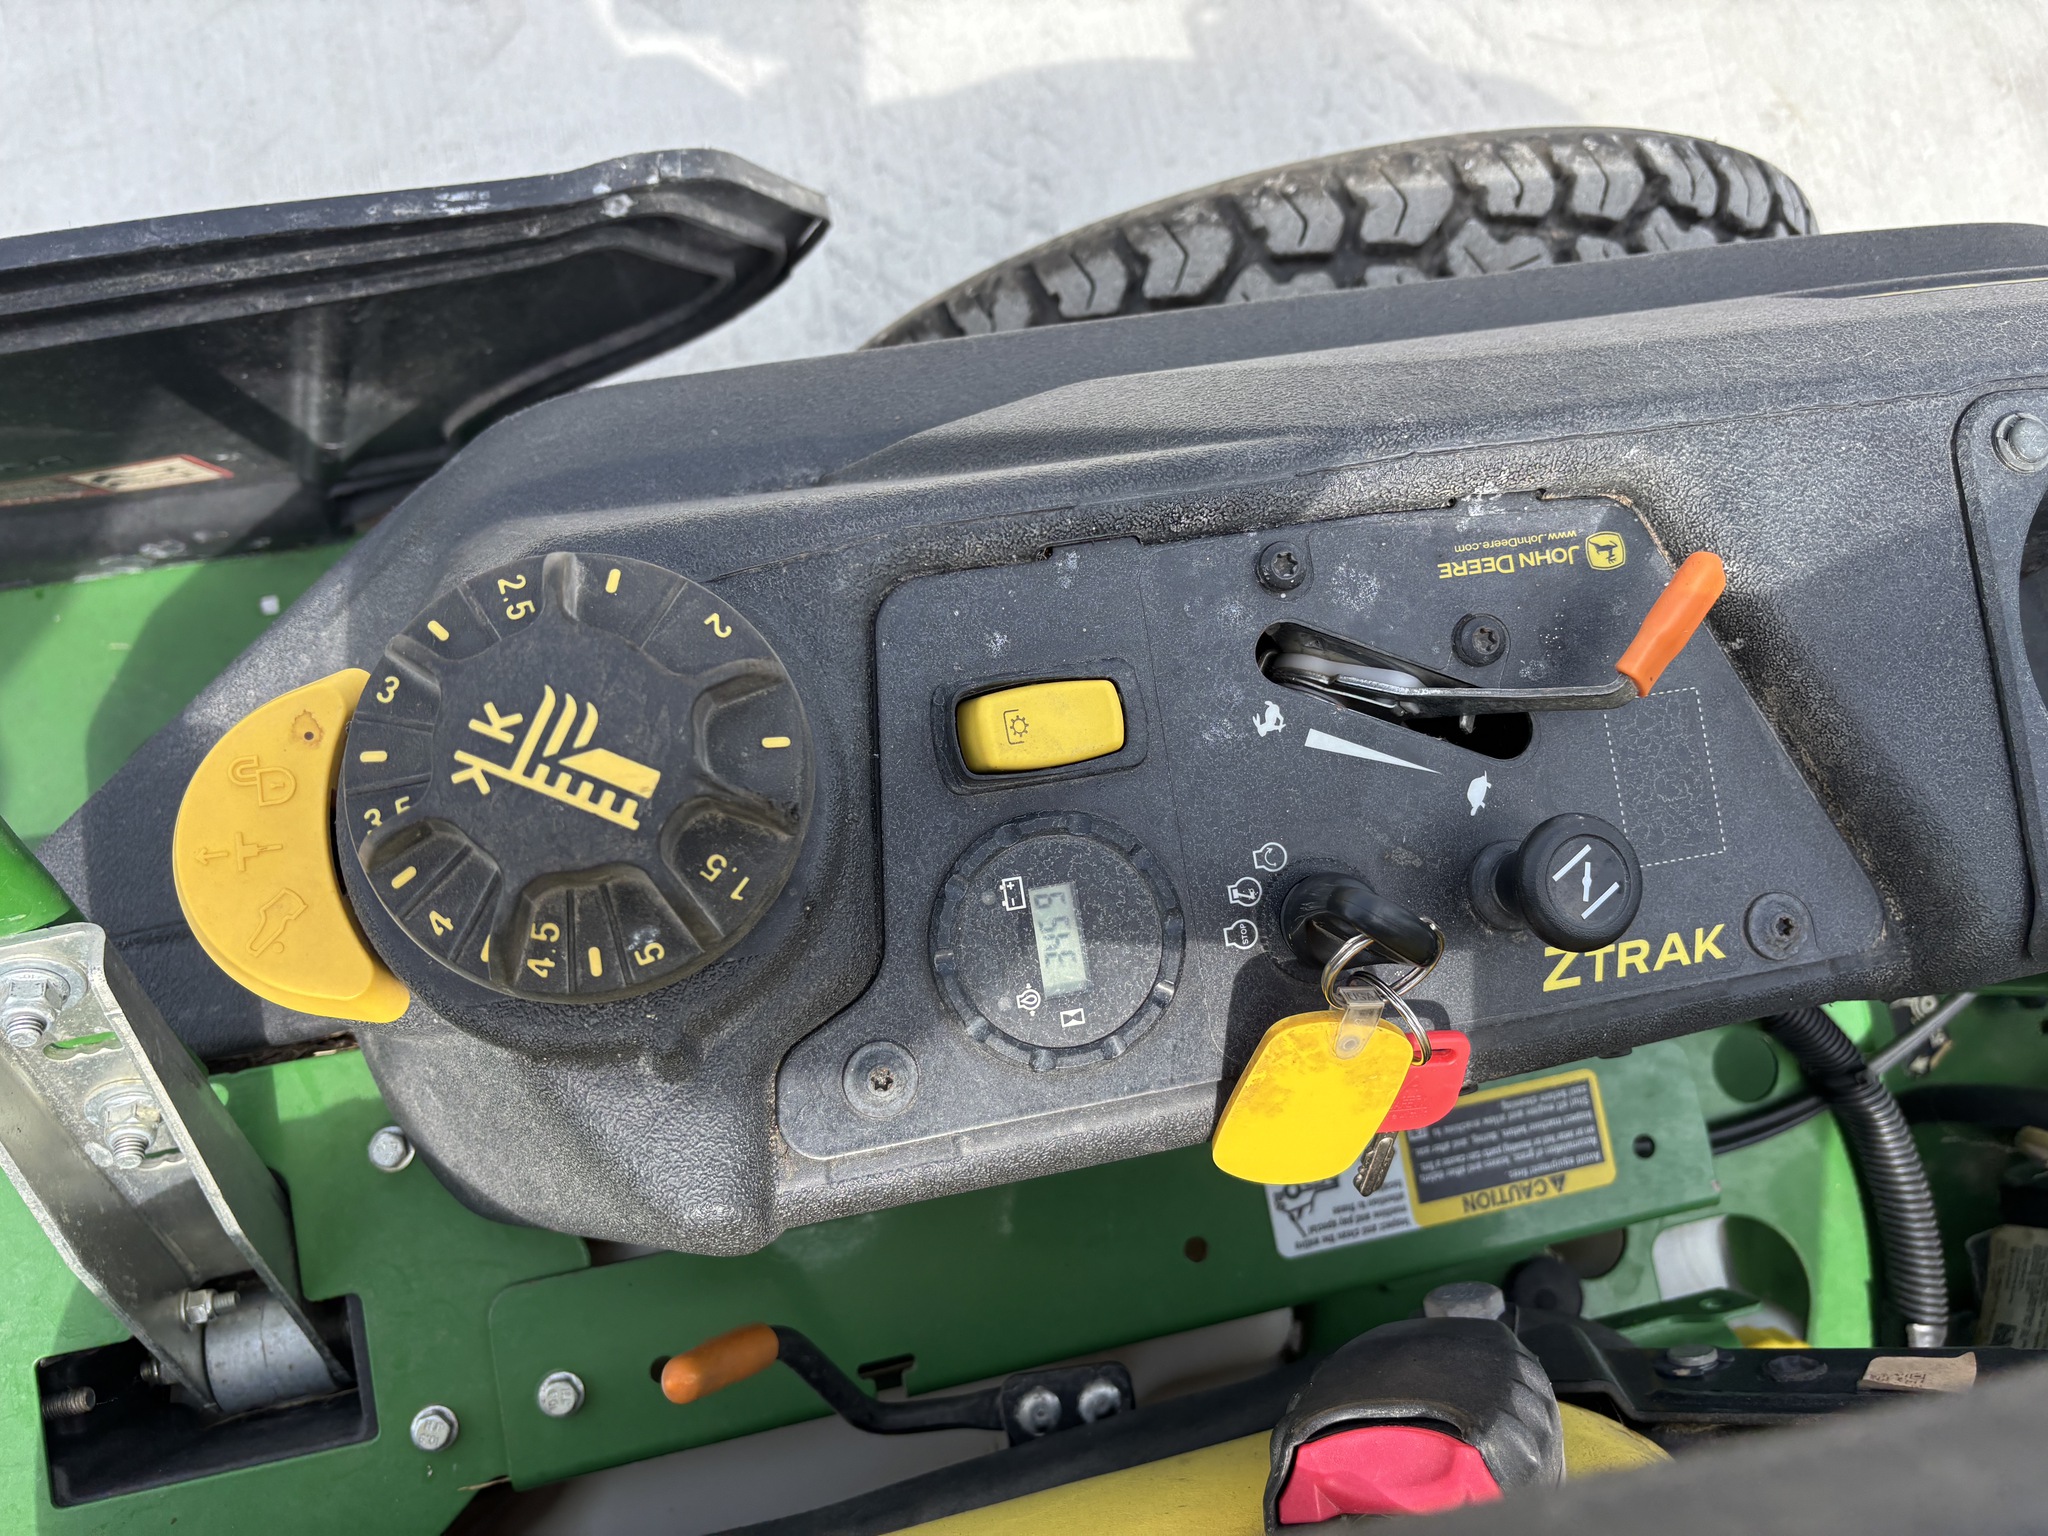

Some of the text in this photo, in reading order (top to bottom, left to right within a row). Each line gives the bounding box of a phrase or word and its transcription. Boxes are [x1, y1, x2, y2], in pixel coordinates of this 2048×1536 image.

[1454, 530, 1577, 553] www.JohnDeere.com
[1437, 545, 1581, 579] JOHN DEERE
[497, 574, 535, 620] 2.5
[704, 612, 733, 639] 2
[376, 676, 400, 703] 3
[700, 853, 751, 902] 1.5
[428, 910, 453, 936] 4
[1240, 923, 1249, 945] STOP
[526, 922, 561, 978] 4.5
[633, 942, 666, 966] 5
[1542, 923, 1727, 992] ZTRAK
[1346, 991, 1376, 1002] USA
[1461, 1178, 1548, 1212] CAUTION
